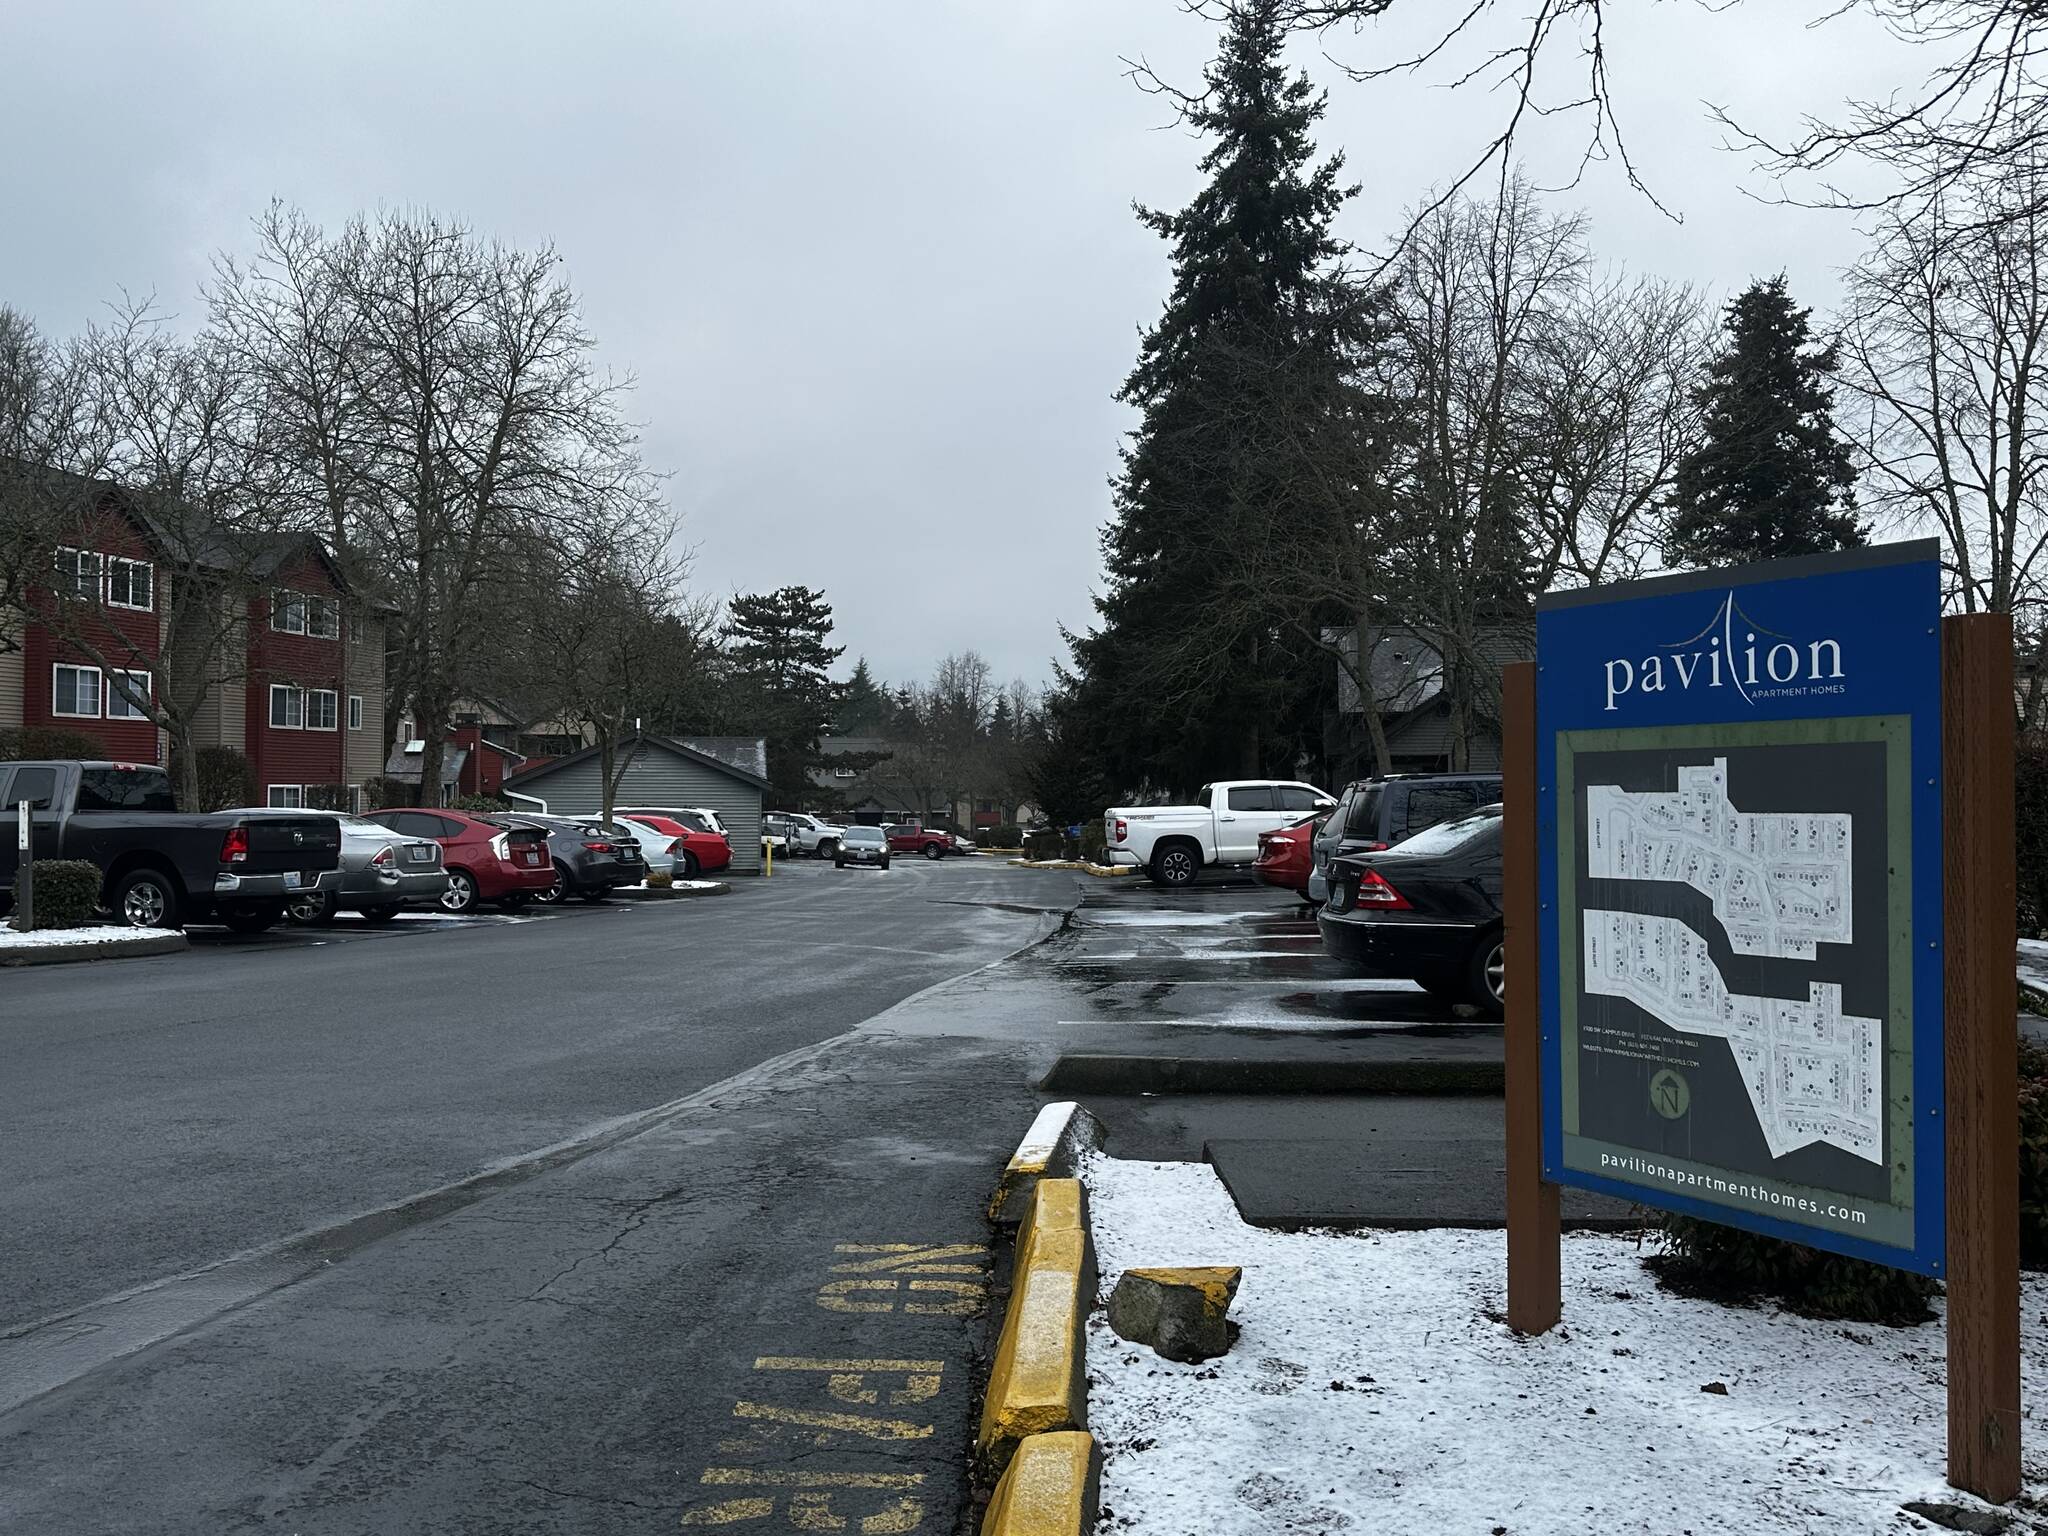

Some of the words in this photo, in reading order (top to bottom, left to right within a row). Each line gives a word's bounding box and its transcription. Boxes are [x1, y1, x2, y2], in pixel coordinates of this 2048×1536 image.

[1603, 590, 1846, 710] pavilion
[1751, 687, 1808, 700] APARTMENT
[1810, 684, 1845, 696] HOMES
[1600, 1152, 1867, 1224] pavilionapartmenthomes.com
[815, 1243, 988, 1315] NO
